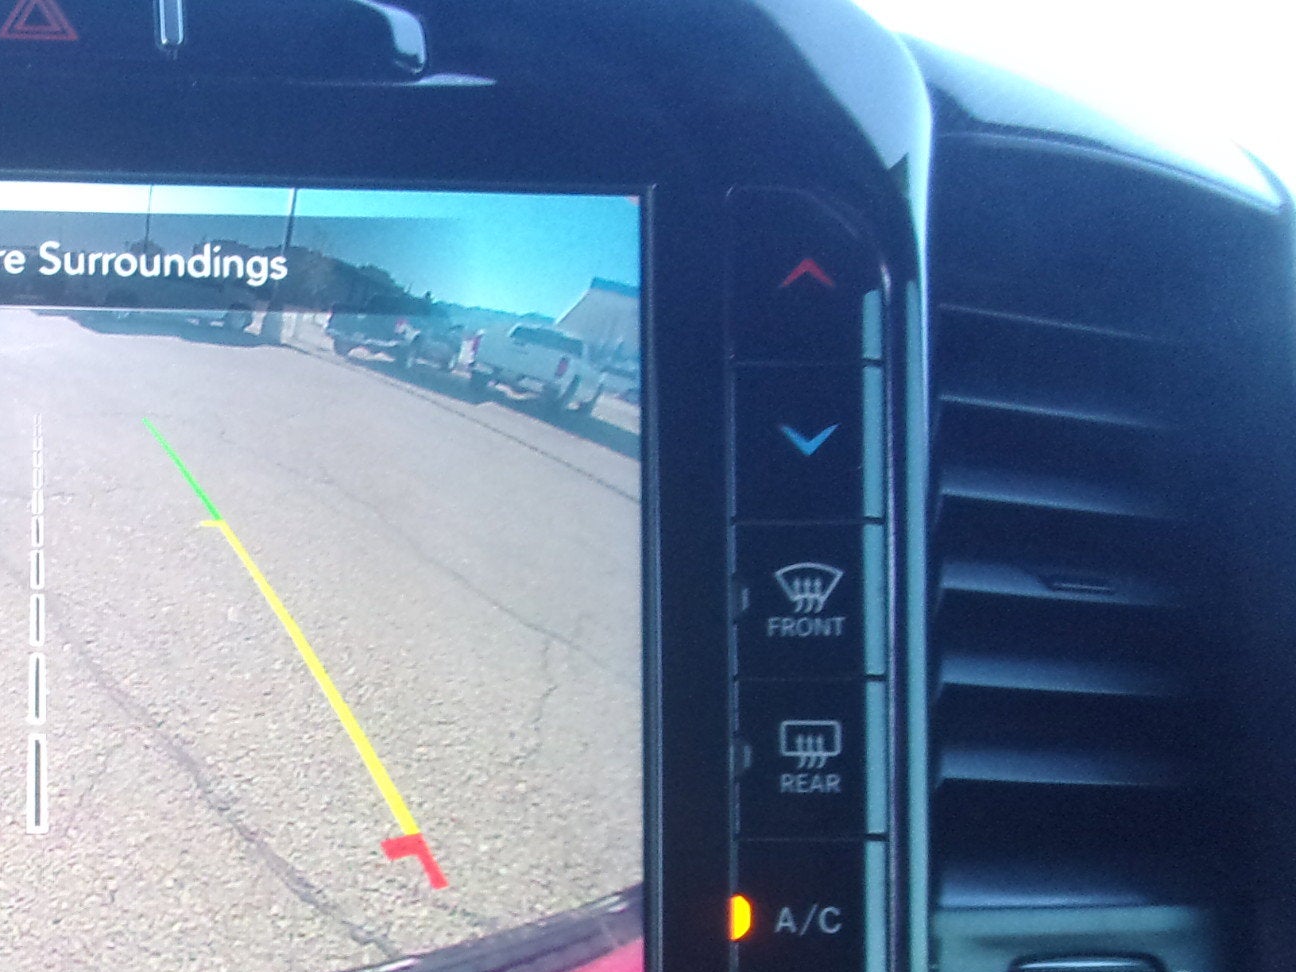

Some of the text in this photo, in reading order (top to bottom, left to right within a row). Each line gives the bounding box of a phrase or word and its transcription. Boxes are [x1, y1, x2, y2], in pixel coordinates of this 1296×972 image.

[39, 238, 290, 286] Surroundings
[766, 616, 846, 638] FRONT
[779, 773, 842, 794] REAR
[774, 904, 843, 935] A/C
